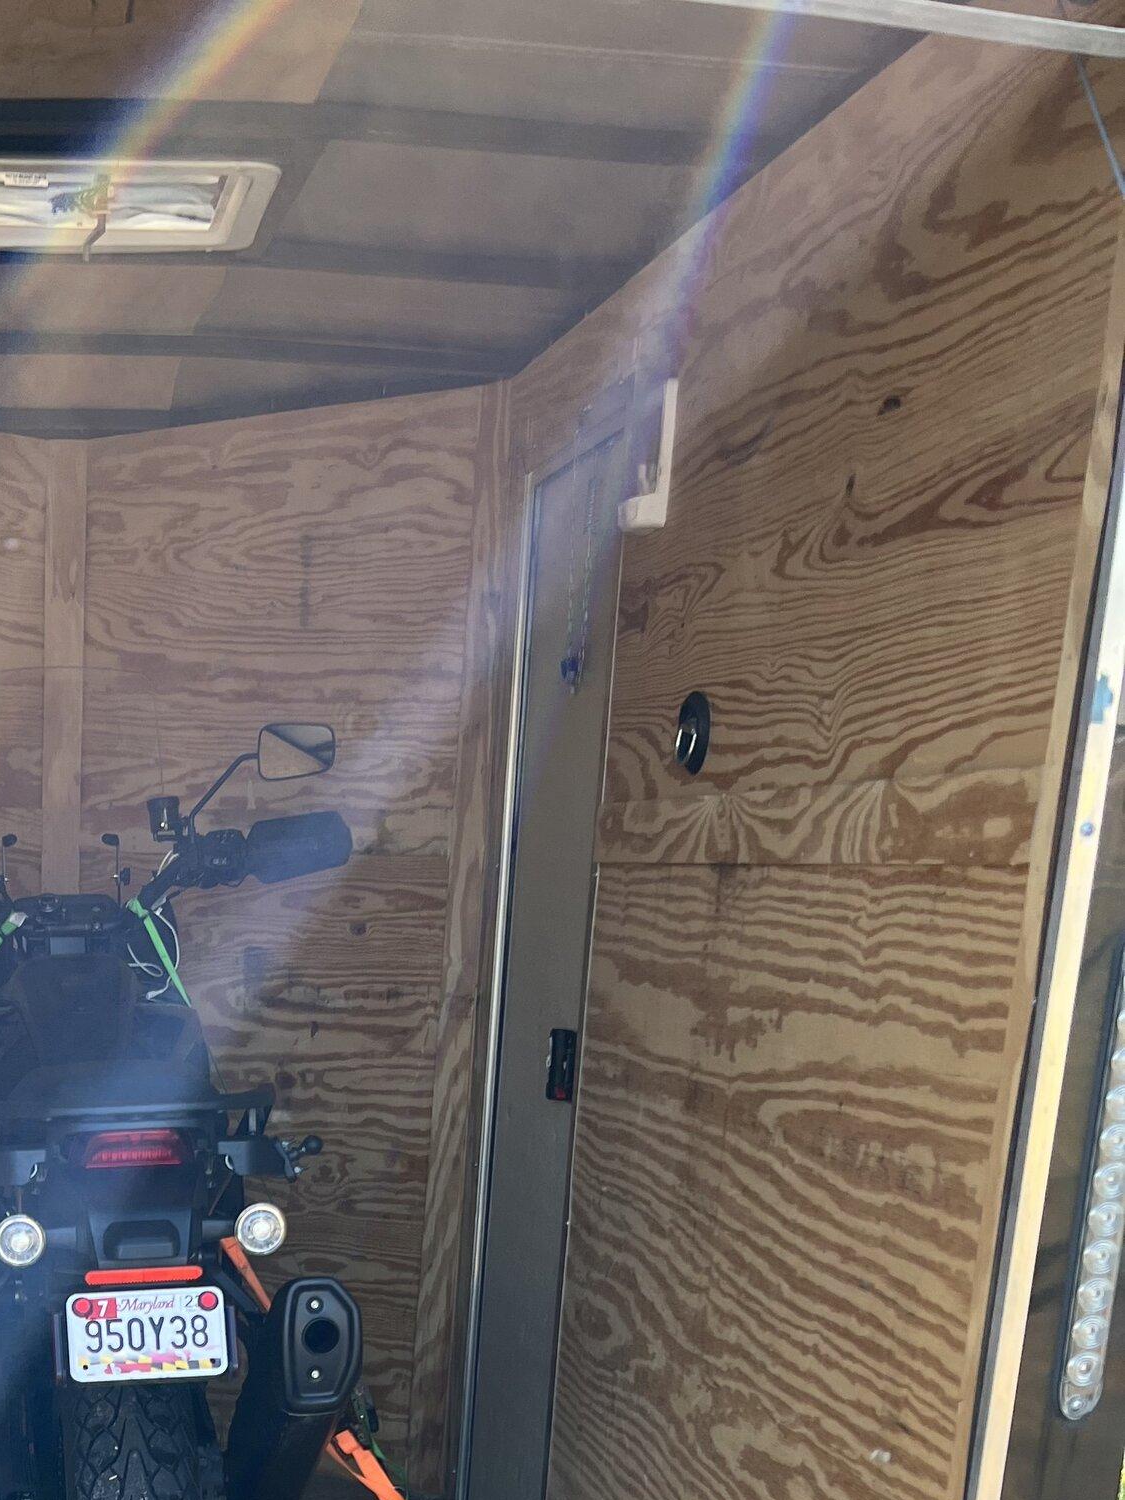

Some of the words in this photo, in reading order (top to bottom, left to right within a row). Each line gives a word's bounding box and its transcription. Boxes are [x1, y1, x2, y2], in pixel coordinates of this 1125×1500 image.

[97, 1300, 109, 1317] 7
[117, 1296, 175, 1314] Maryland
[85, 1314, 209, 1353] 950Y38
